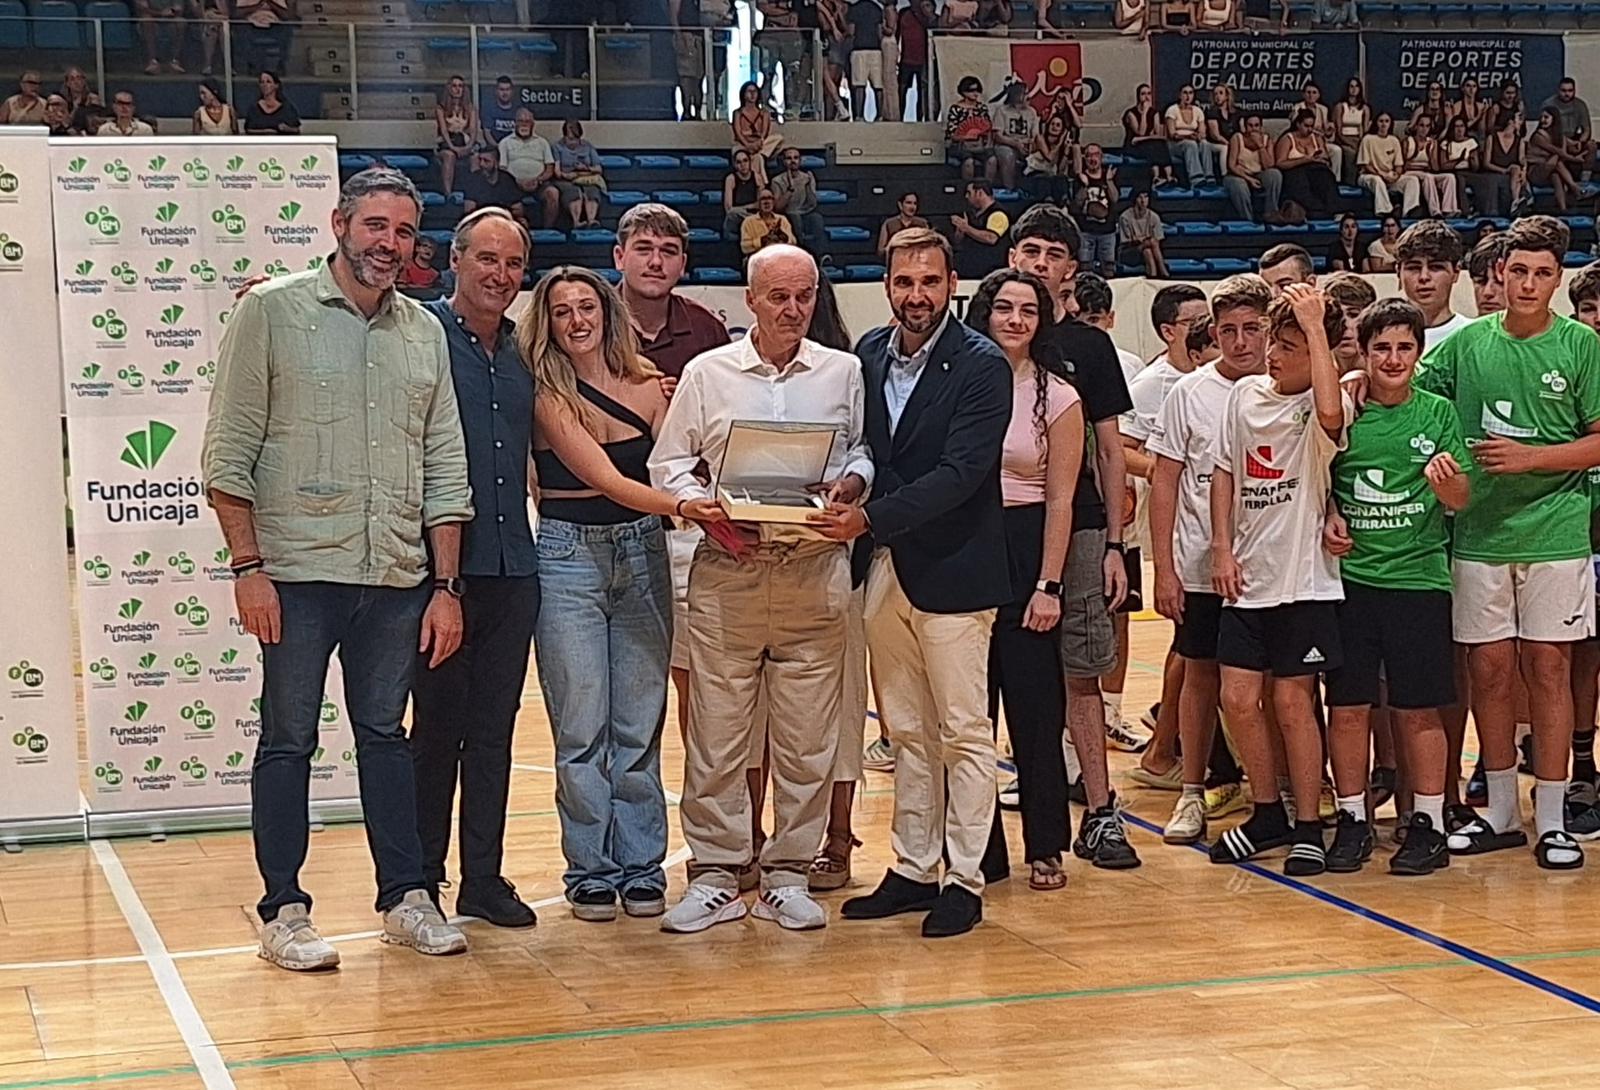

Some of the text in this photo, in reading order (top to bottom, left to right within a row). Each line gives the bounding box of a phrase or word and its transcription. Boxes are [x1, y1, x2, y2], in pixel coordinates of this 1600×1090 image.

[1192, 40, 1315, 49] PATRONATO MUNICIPAL DE
[1401, 40, 1521, 48] PATRONATO MUNICIPAL DE
[1190, 52, 1315, 69] DEPORTES
[1400, 51, 1522, 68] DEPORTES
[1192, 73, 1219, 90] DE
[1402, 72, 1429, 88] DE
[521, 89, 562, 103] Sector
[141, 225, 197, 237] Fundación
[264, 224, 318, 235] Fundación
[150, 236, 190, 247] Unicaja
[273, 234, 311, 246] Unicaja
[146, 328, 202, 339] Fundación
[154, 338, 194, 349] Unicaja
[107, 499, 199, 526] Unicaja
[1342, 503, 1425, 517] CONANIFER
[121, 569, 165, 579] Fundación
[128, 577, 158, 586] Unicaja
[104, 622, 160, 634] Fundación
[112, 632, 153, 644] Unicaja
[127, 671, 171, 681] Fundación
[209, 667, 251, 676] Fundación
[134, 679, 165, 688] Unicaja
[215, 674, 246, 683] Unicaja
[110, 724, 166, 737] Fundación
[118, 733, 158, 746] Unicaja
[133, 774, 176, 784] Fundación
[139, 783, 170, 792] Unicaja
